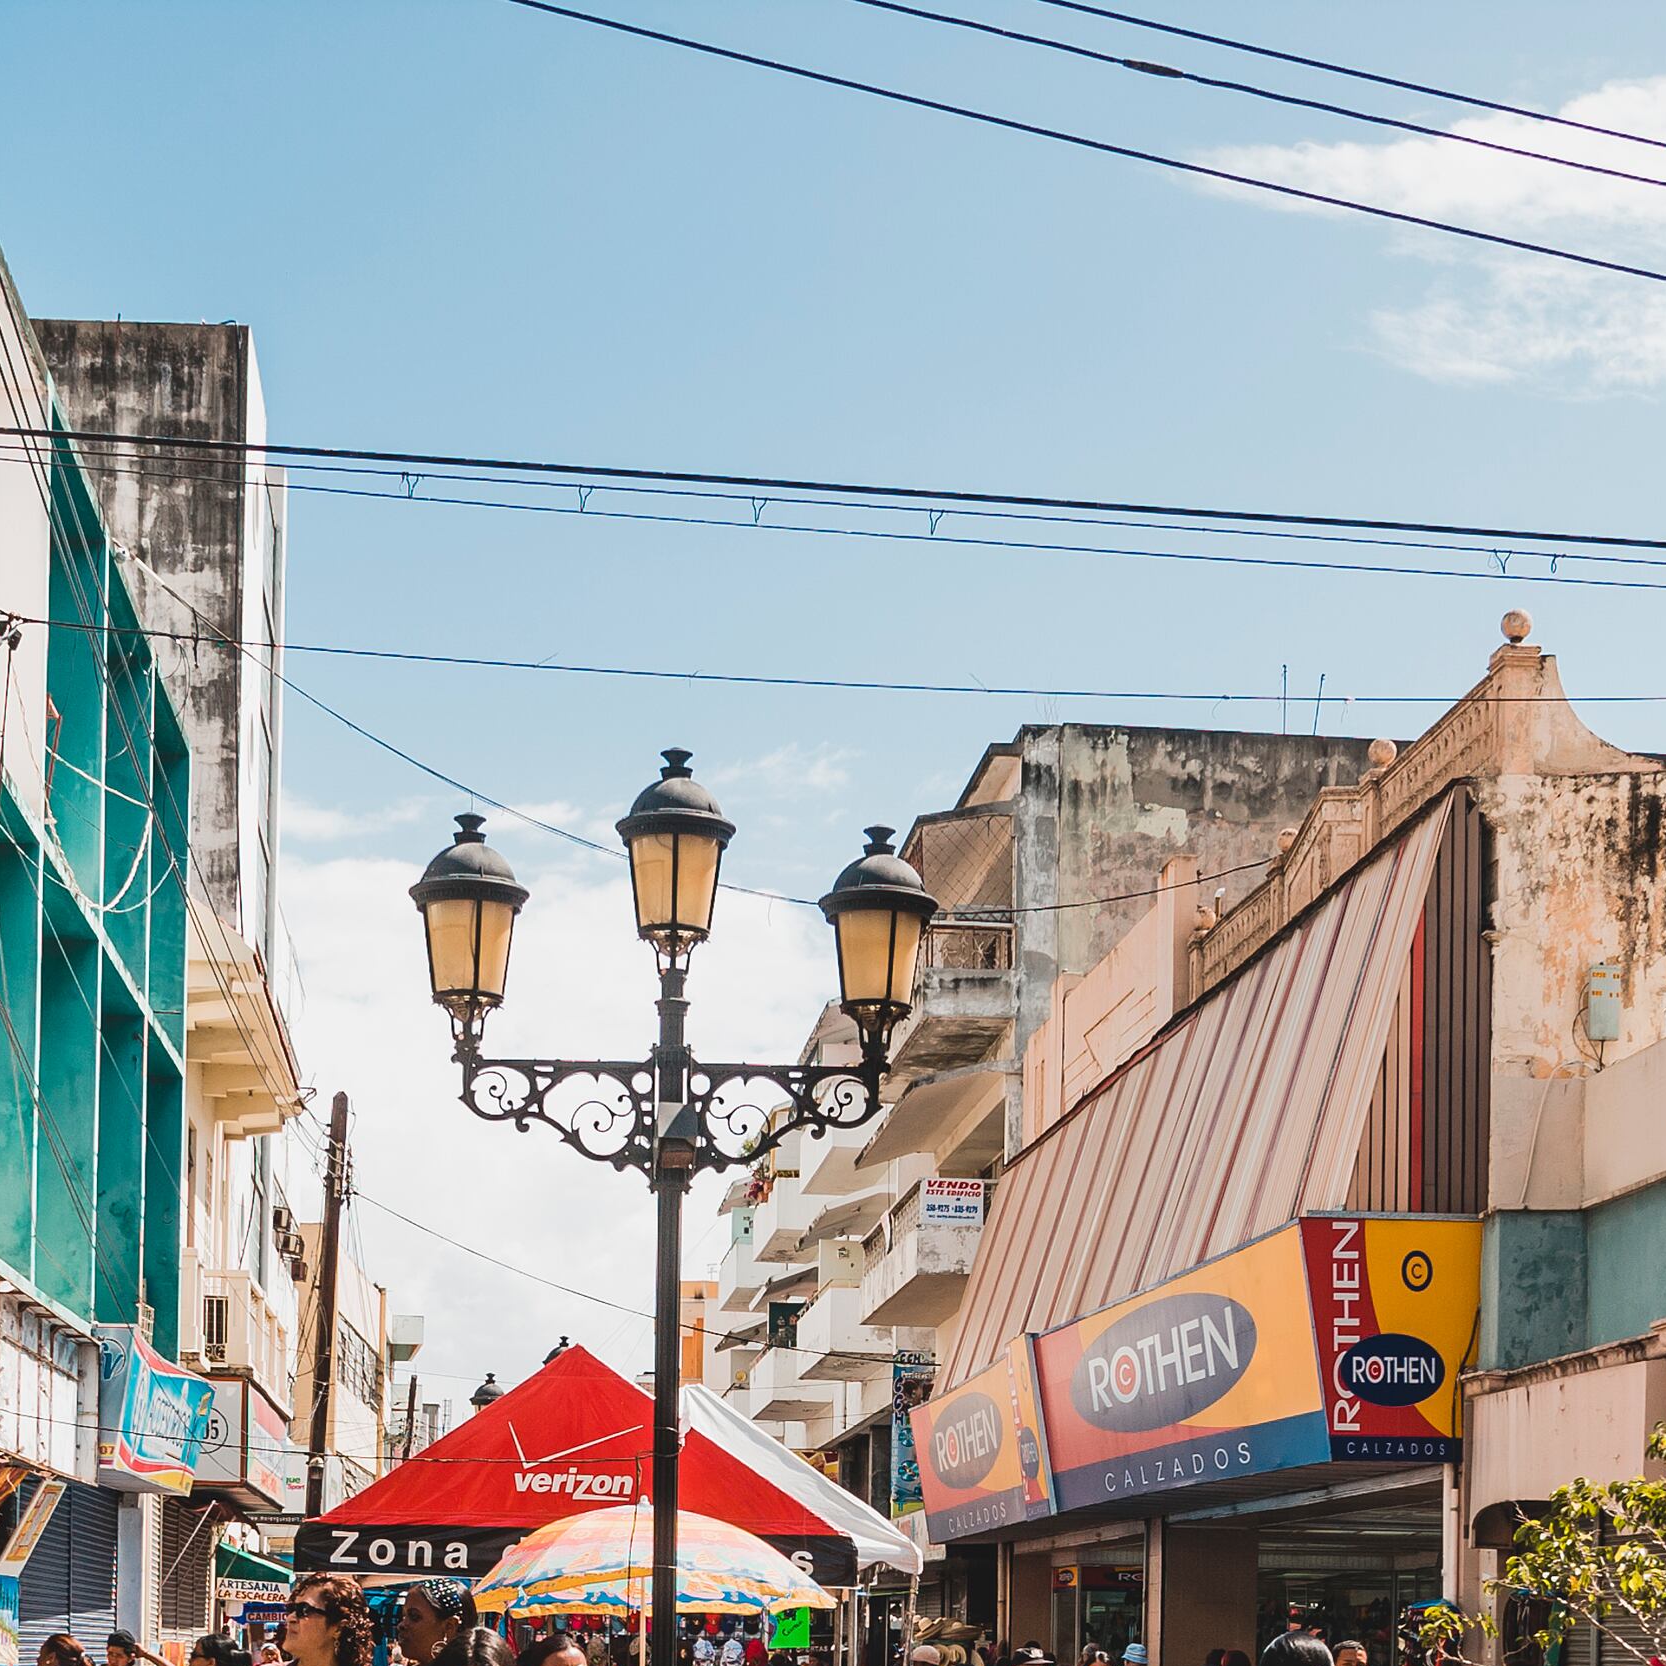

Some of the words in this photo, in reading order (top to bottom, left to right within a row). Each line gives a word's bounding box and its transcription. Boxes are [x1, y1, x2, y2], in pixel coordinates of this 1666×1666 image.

[927, 1180, 981, 1191] VENDO
[1088, 1305, 1240, 1413] ROTHEN
[1351, 1355, 1436, 1385] ROTHEN
[935, 1404, 998, 1473] ROTHEN
[1346, 1441, 1446, 1456] CALZADOS
[1104, 1440, 1253, 1494] CALZADOS
[514, 1467, 634, 1501] verizon
[948, 1501, 1007, 1533] CALZADOS
[330, 1530, 469, 1570] Zona
[217, 1590, 232, 1598] LA
[235, 1591, 287, 1602] ESCALERA
[219, 1579, 281, 1593] ARTESANIA
